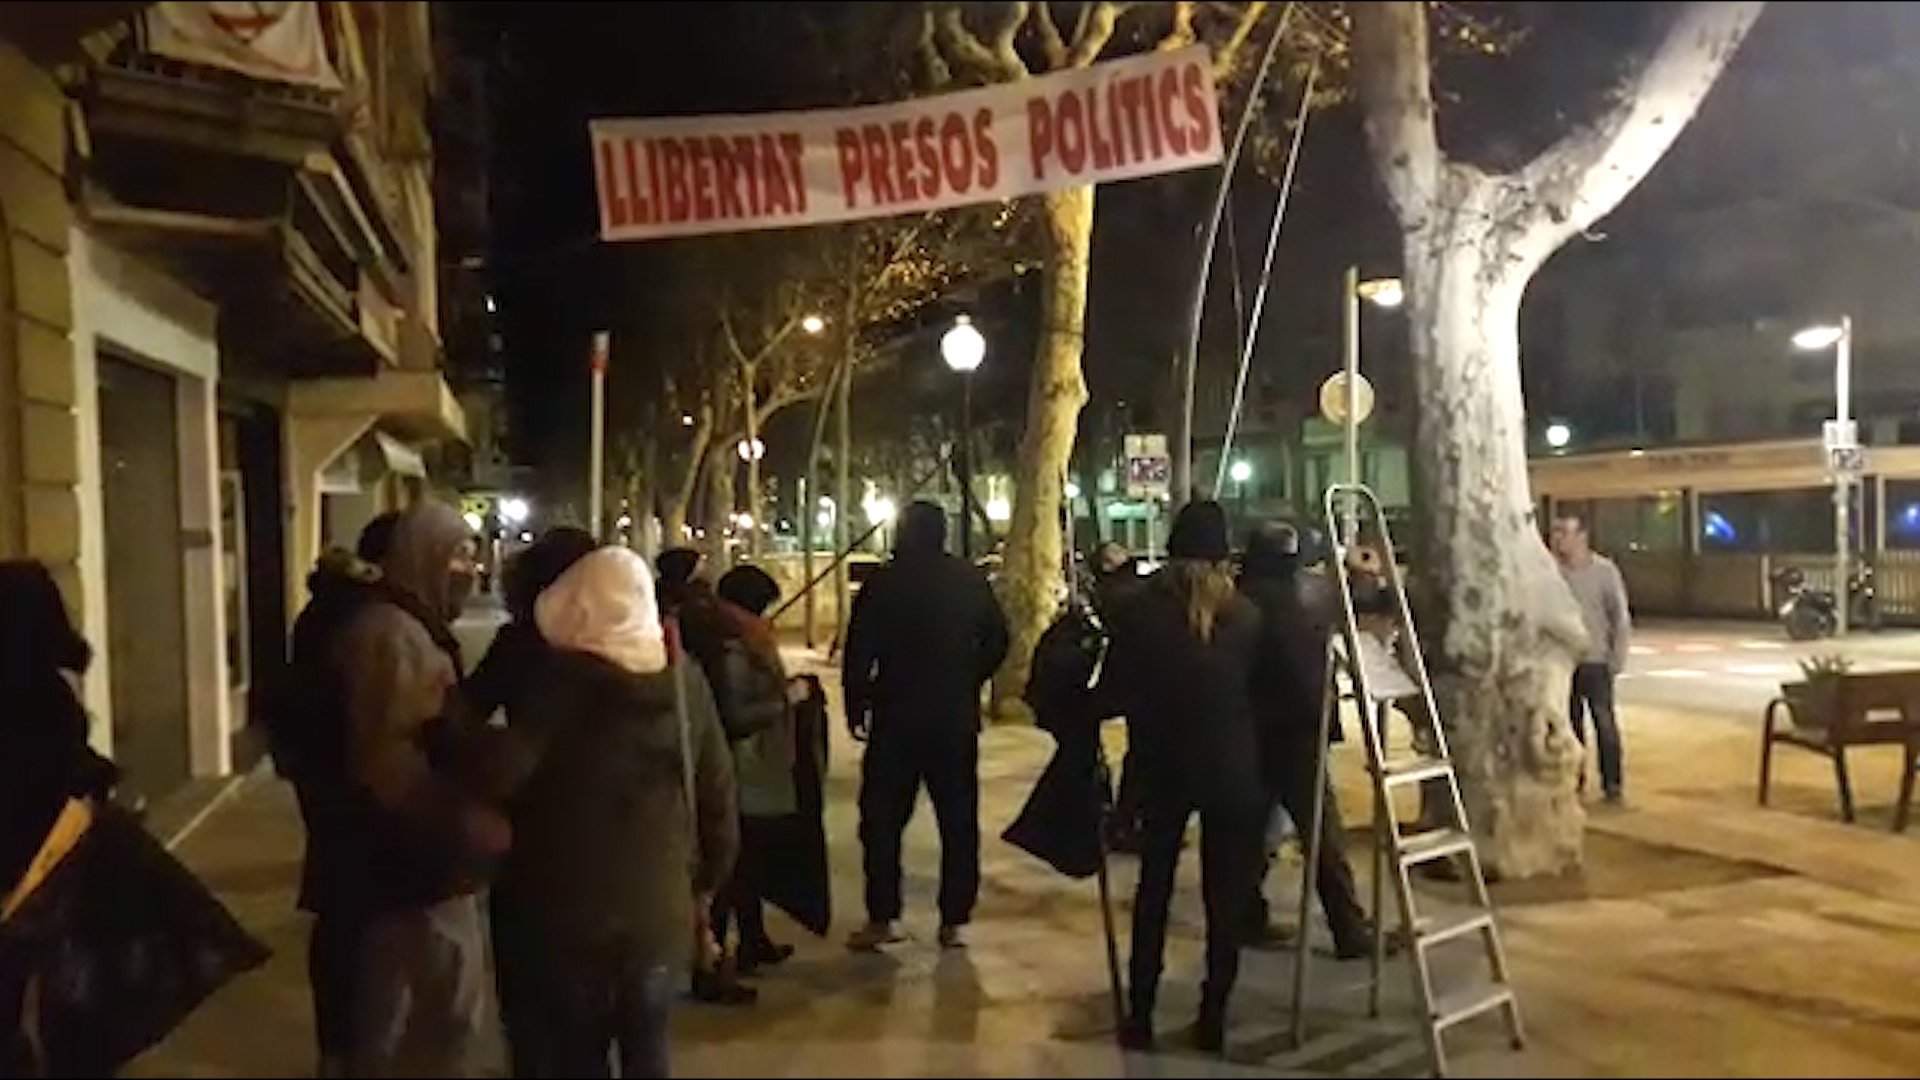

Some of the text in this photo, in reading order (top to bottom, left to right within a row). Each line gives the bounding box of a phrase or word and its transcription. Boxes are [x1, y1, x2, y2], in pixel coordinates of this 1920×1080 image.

[602, 63, 1211, 226] LLIBERTAT PRESOS POLÍTICS
